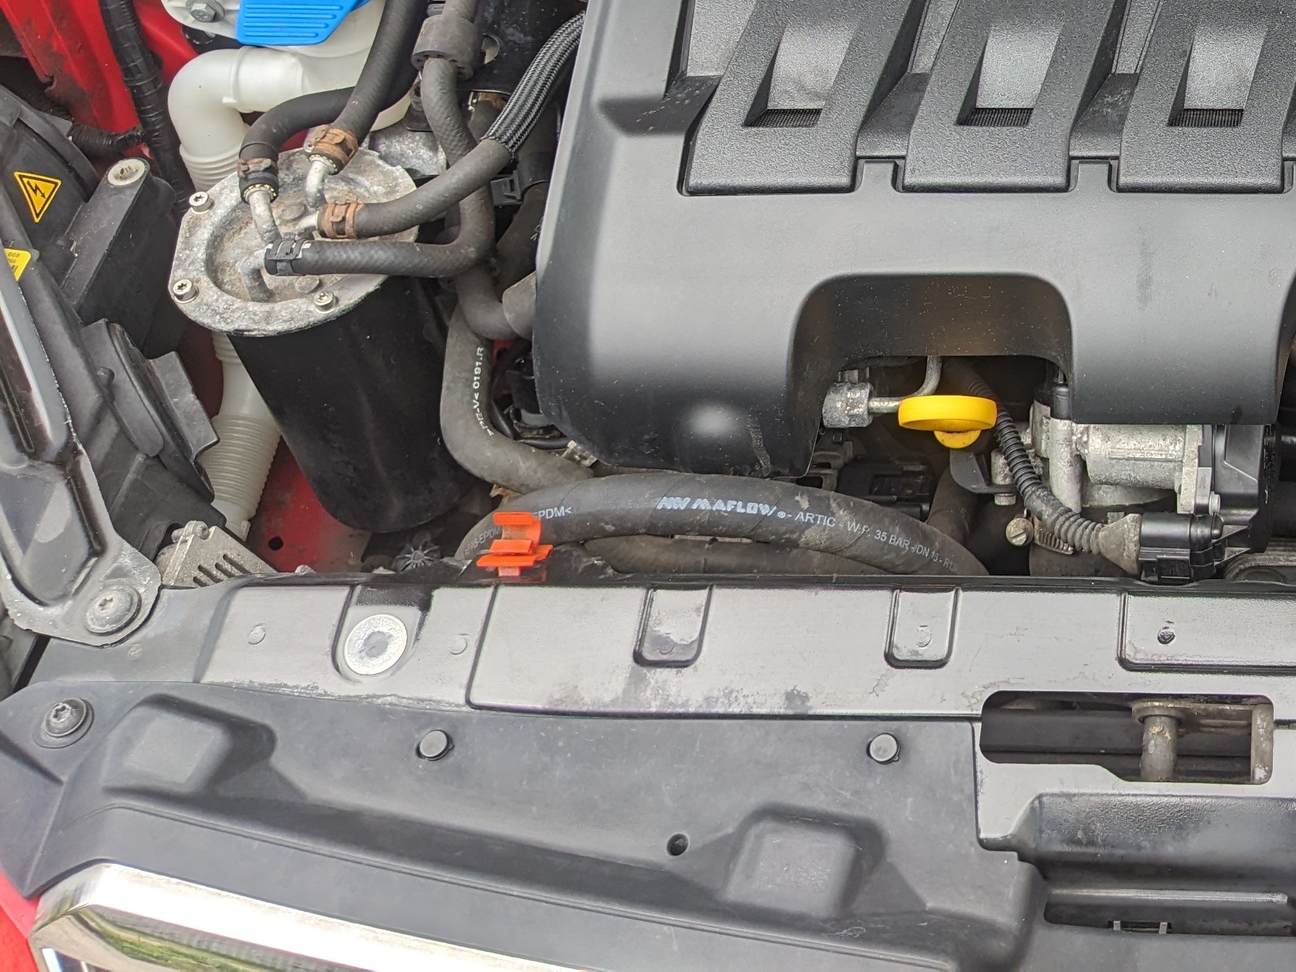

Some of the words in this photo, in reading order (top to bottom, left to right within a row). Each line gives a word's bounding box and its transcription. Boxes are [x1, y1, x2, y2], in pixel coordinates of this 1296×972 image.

[794, 509, 836, 528] ARTIC
[874, 529, 888, 543] 35
[888, 531, 911, 551] BAR
